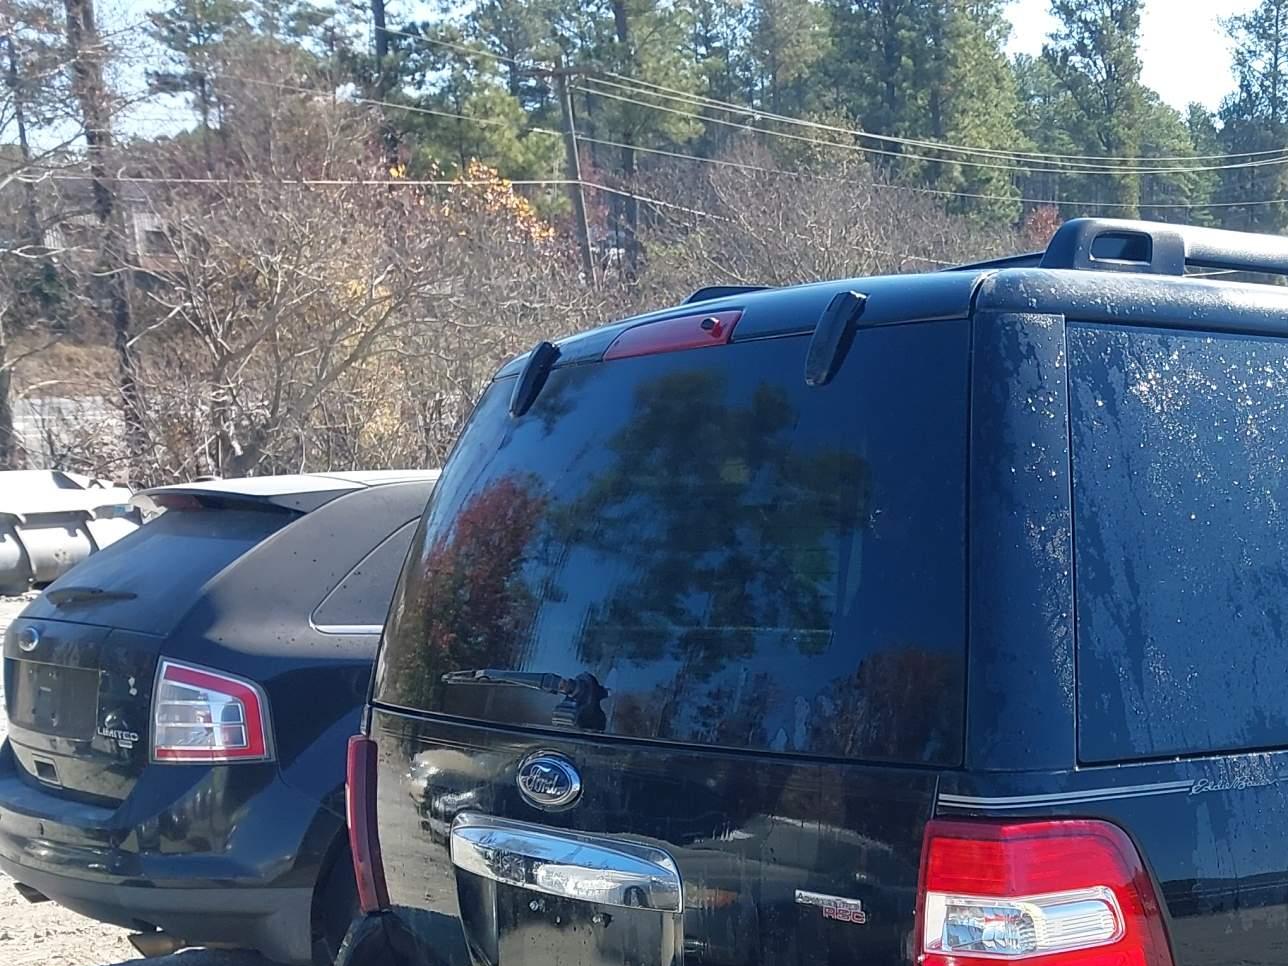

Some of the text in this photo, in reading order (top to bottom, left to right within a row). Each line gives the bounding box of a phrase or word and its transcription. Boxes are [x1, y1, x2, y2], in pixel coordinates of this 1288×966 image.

[97, 727, 139, 741] LIMITED
[521, 764, 563, 796] Ford
[1188, 778, 1233, 795] Eddie
[823, 905, 866, 924] RSC
